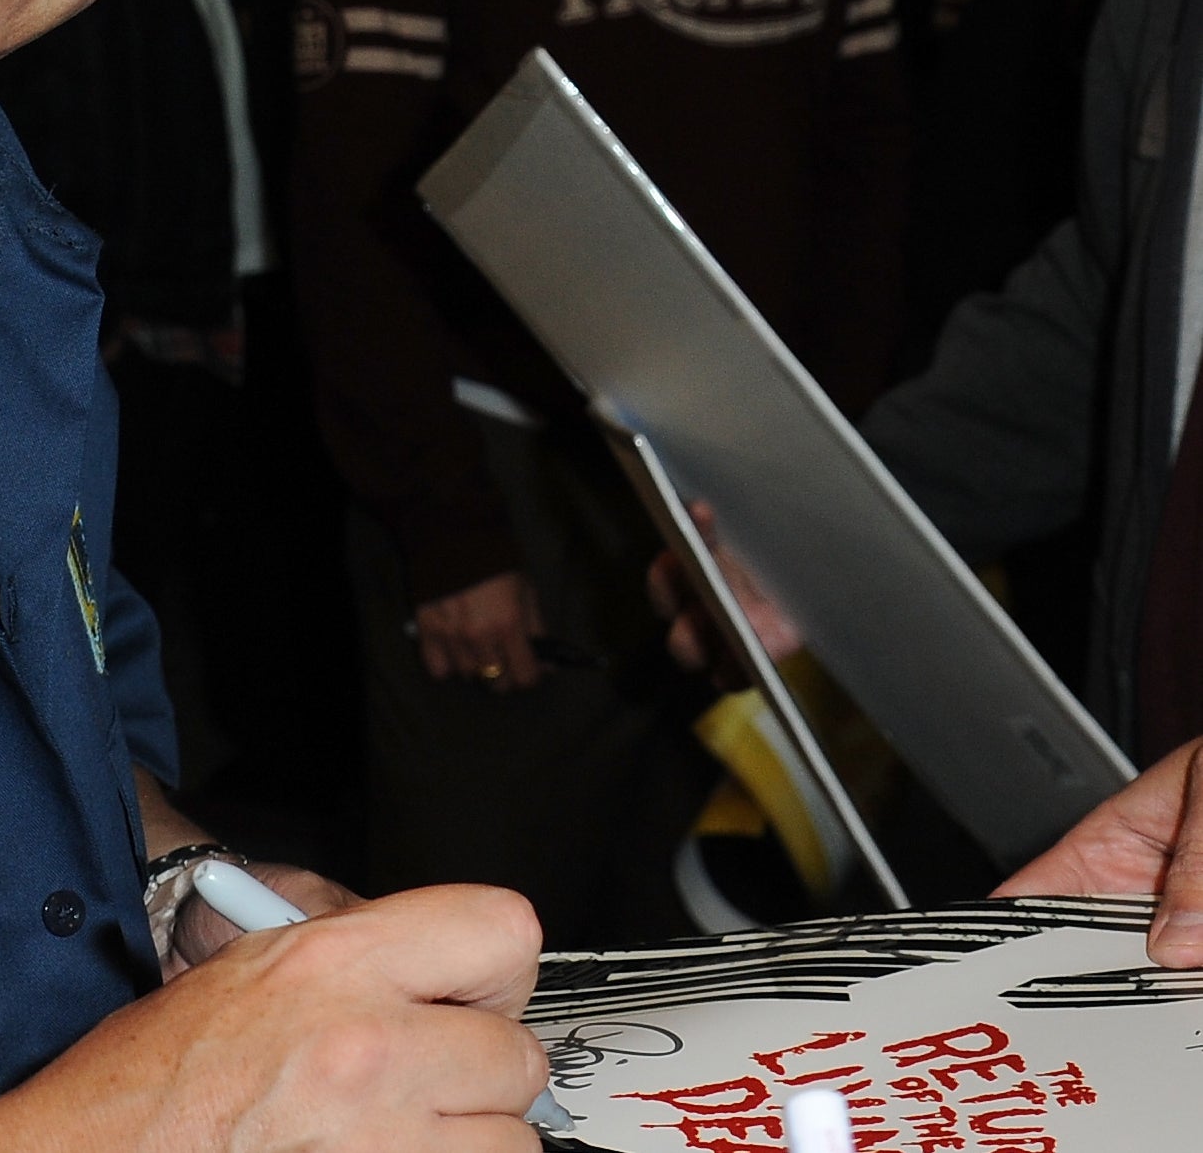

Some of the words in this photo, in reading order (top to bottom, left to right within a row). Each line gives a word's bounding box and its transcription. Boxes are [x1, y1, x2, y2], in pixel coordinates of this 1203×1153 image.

[887, 1077, 943, 1102] OF
[1036, 1062, 1097, 1107] THE
[900, 1106, 965, 1153] THE
